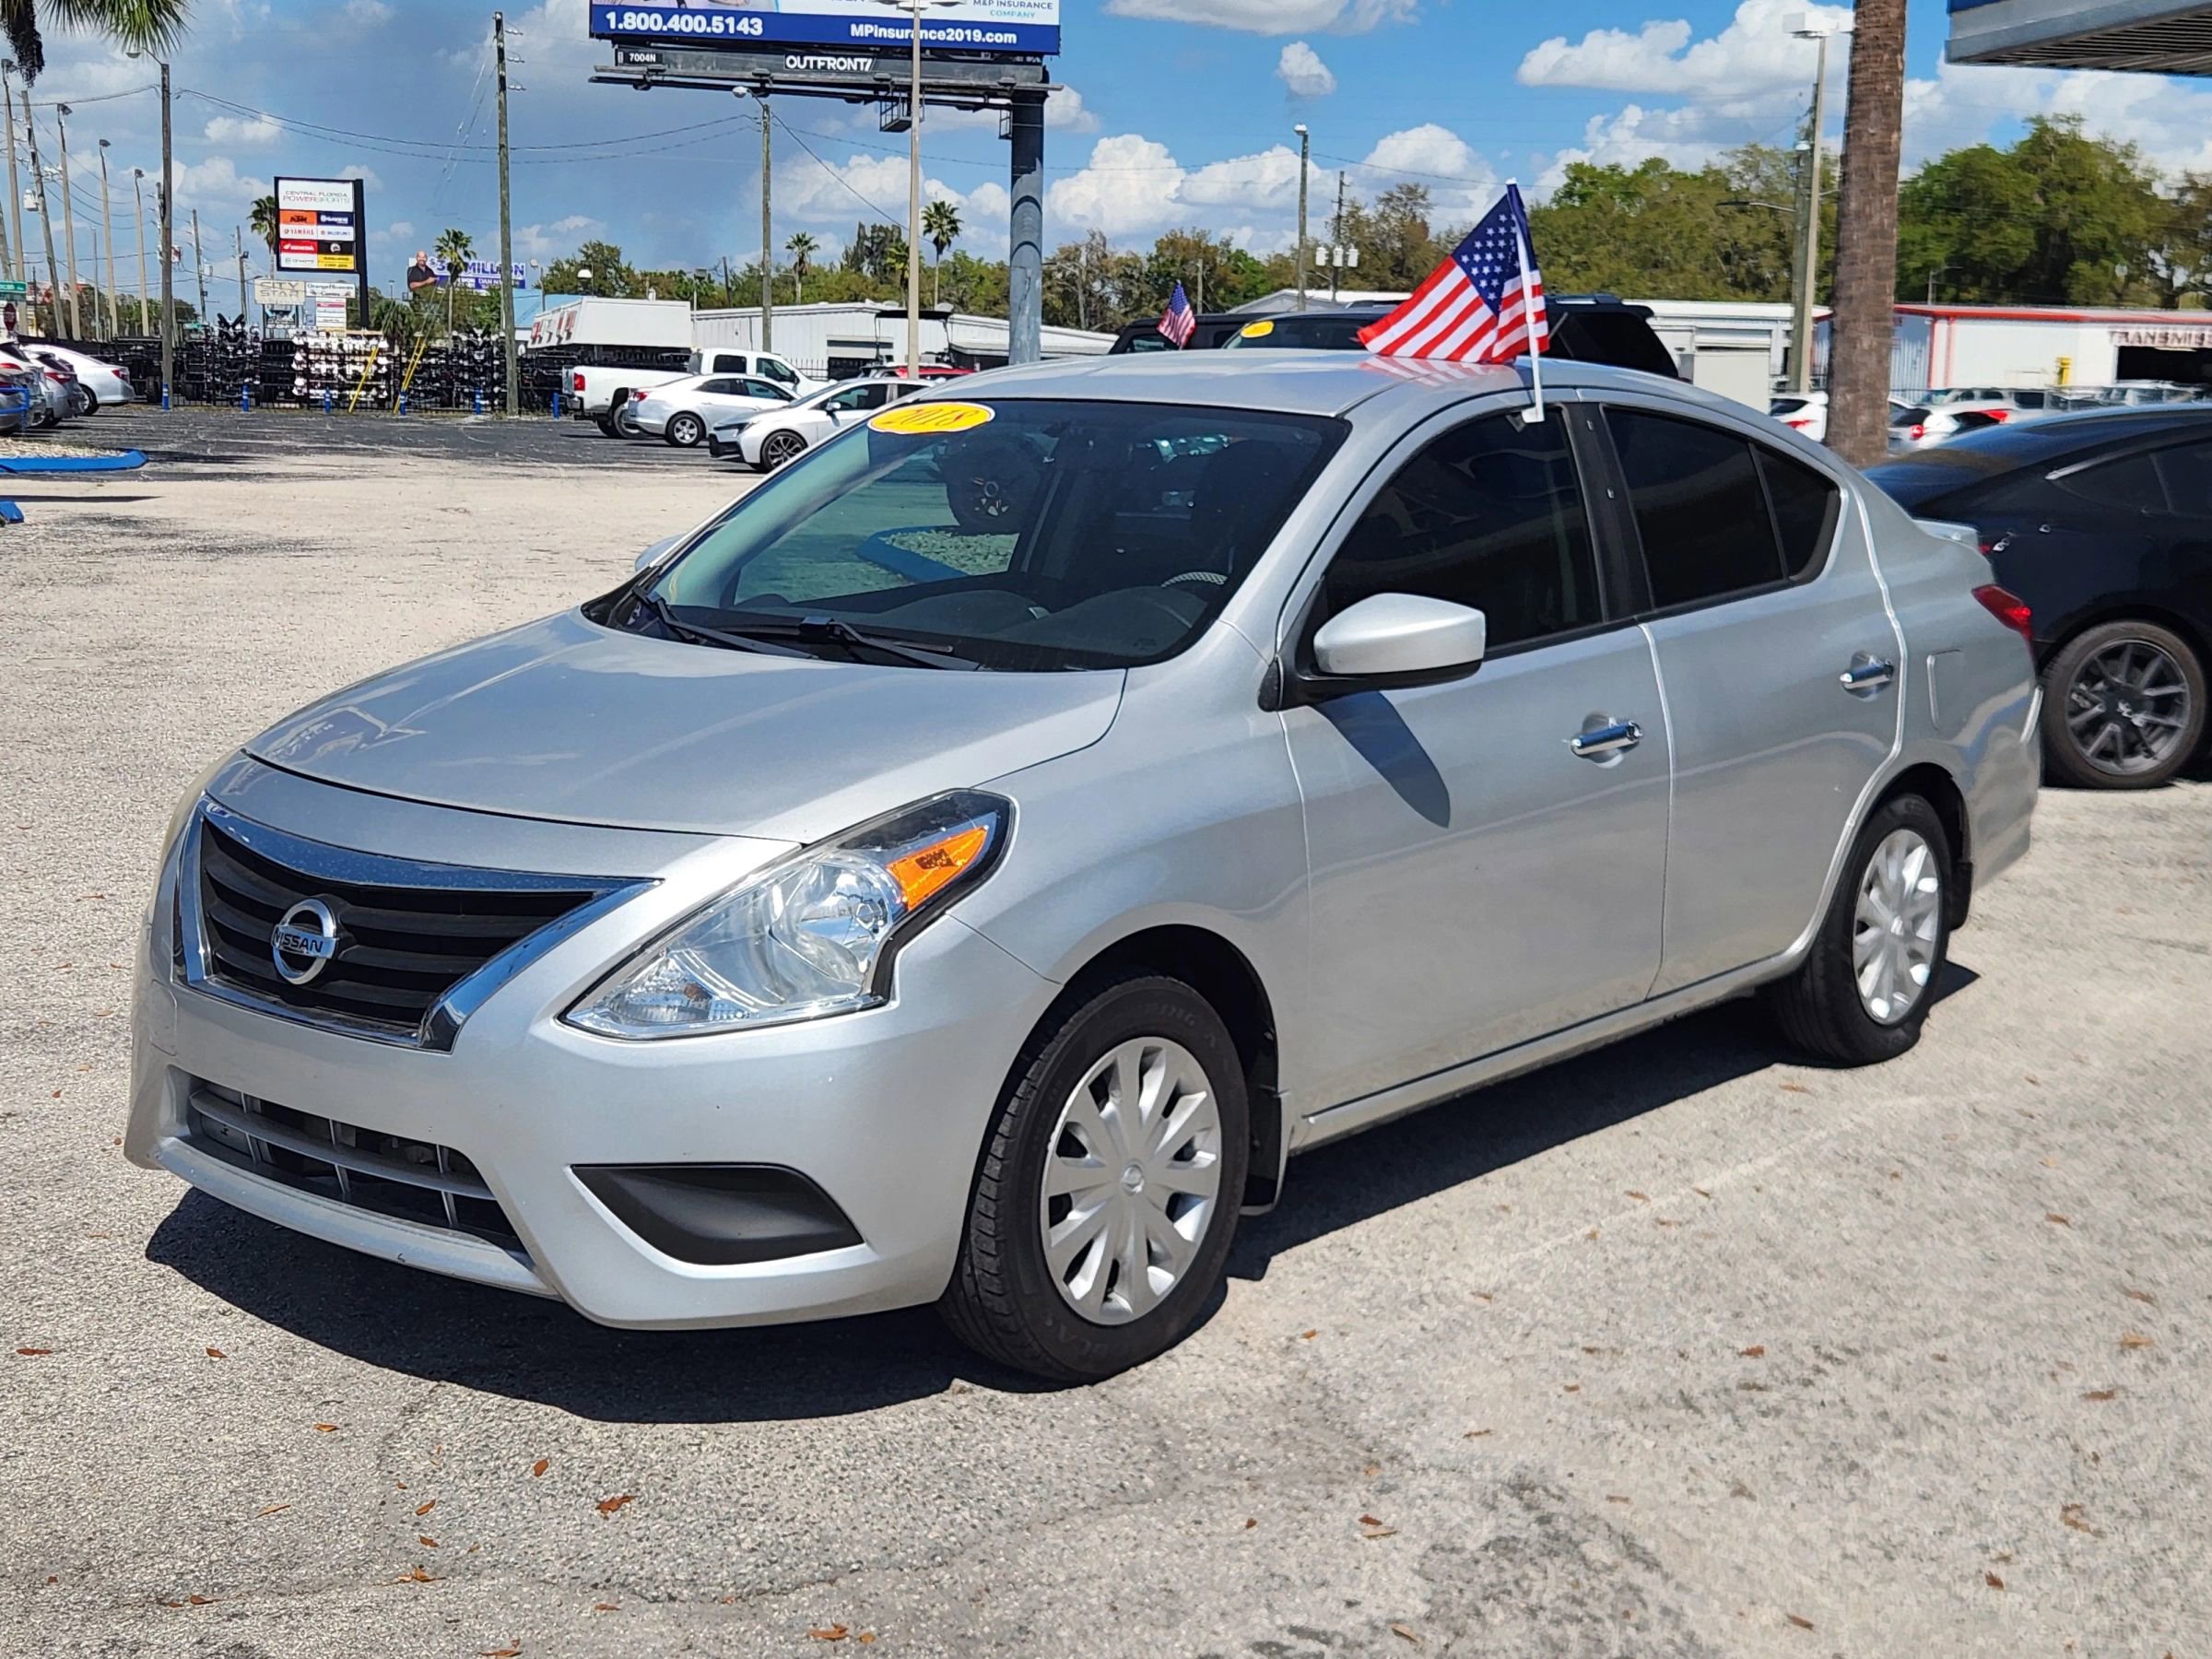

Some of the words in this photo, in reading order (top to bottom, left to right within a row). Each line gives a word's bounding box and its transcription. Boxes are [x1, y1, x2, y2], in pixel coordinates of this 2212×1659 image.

[996, 1, 1053, 10] INSURANCE
[990, 9, 1036, 18] COMPANY
[606, 11, 763, 36] 1.800.400.5143
[629, 53, 656, 63] 7004N
[260, 281, 300, 289] CITY
[260, 289, 299, 298] STAR
[274, 931, 324, 953] NISSAN
